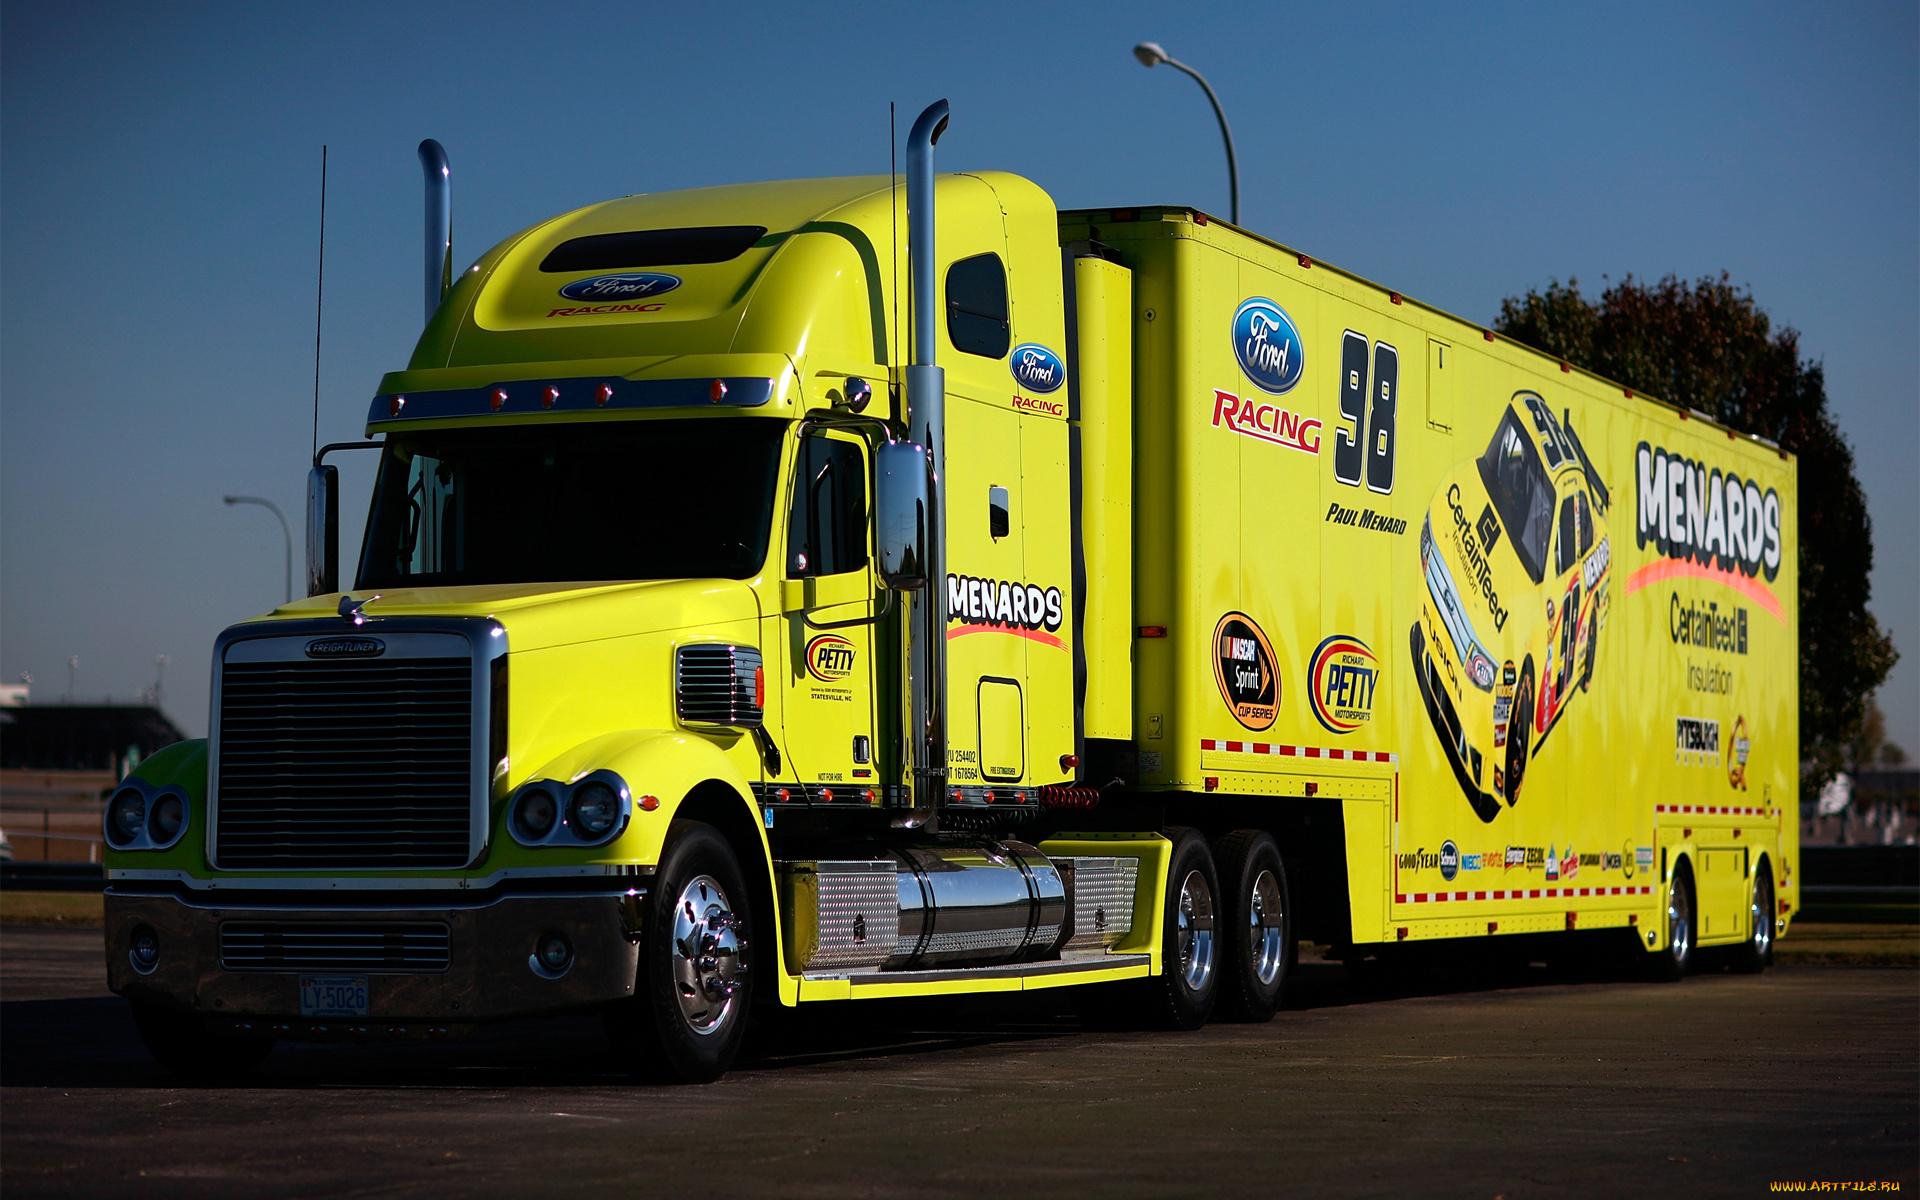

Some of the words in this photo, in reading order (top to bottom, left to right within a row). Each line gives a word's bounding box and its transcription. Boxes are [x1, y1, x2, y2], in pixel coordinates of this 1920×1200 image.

[581, 276, 659, 296] Ford
[546, 303, 667, 318] RACING
[1245, 310, 1290, 379] Ford
[1019, 350, 1055, 385] Ford
[1011, 395, 1064, 416] RACING
[1333, 328, 1400, 496] 98
[1211, 387, 1323, 456] RACING
[1325, 502, 1358, 527] PAUL
[1358, 508, 1407, 536] MENARD
[1635, 441, 1782, 584] MENARDS
[1447, 483, 1509, 634] CertainTeed
[1452, 530, 1478, 596] Insulation
[946, 573, 1063, 633] MENARDS
[1670, 591, 1736, 654] CertainTeed
[313, 642, 375, 653] FREIGHTLINER
[816, 648, 857, 671] PETTY
[1231, 637, 1256, 662] NASCAR
[1342, 654, 1364, 666] RICHARD
[1423, 603, 1462, 703] FUSION
[823, 669, 851, 677] MOTORSPORTS
[1235, 665, 1259, 694] Sprint
[1325, 663, 1380, 710] PETTY
[1687, 656, 1733, 695] Insulation
[811, 693, 844, 702] STATESVILLE,
[1238, 705, 1251, 718] CUP
[1251, 706, 1274, 720] SERIES
[1334, 709, 1371, 721] MOTORSPORTS
[955, 751, 976, 763] 254402
[954, 767, 978, 780] 1678564
